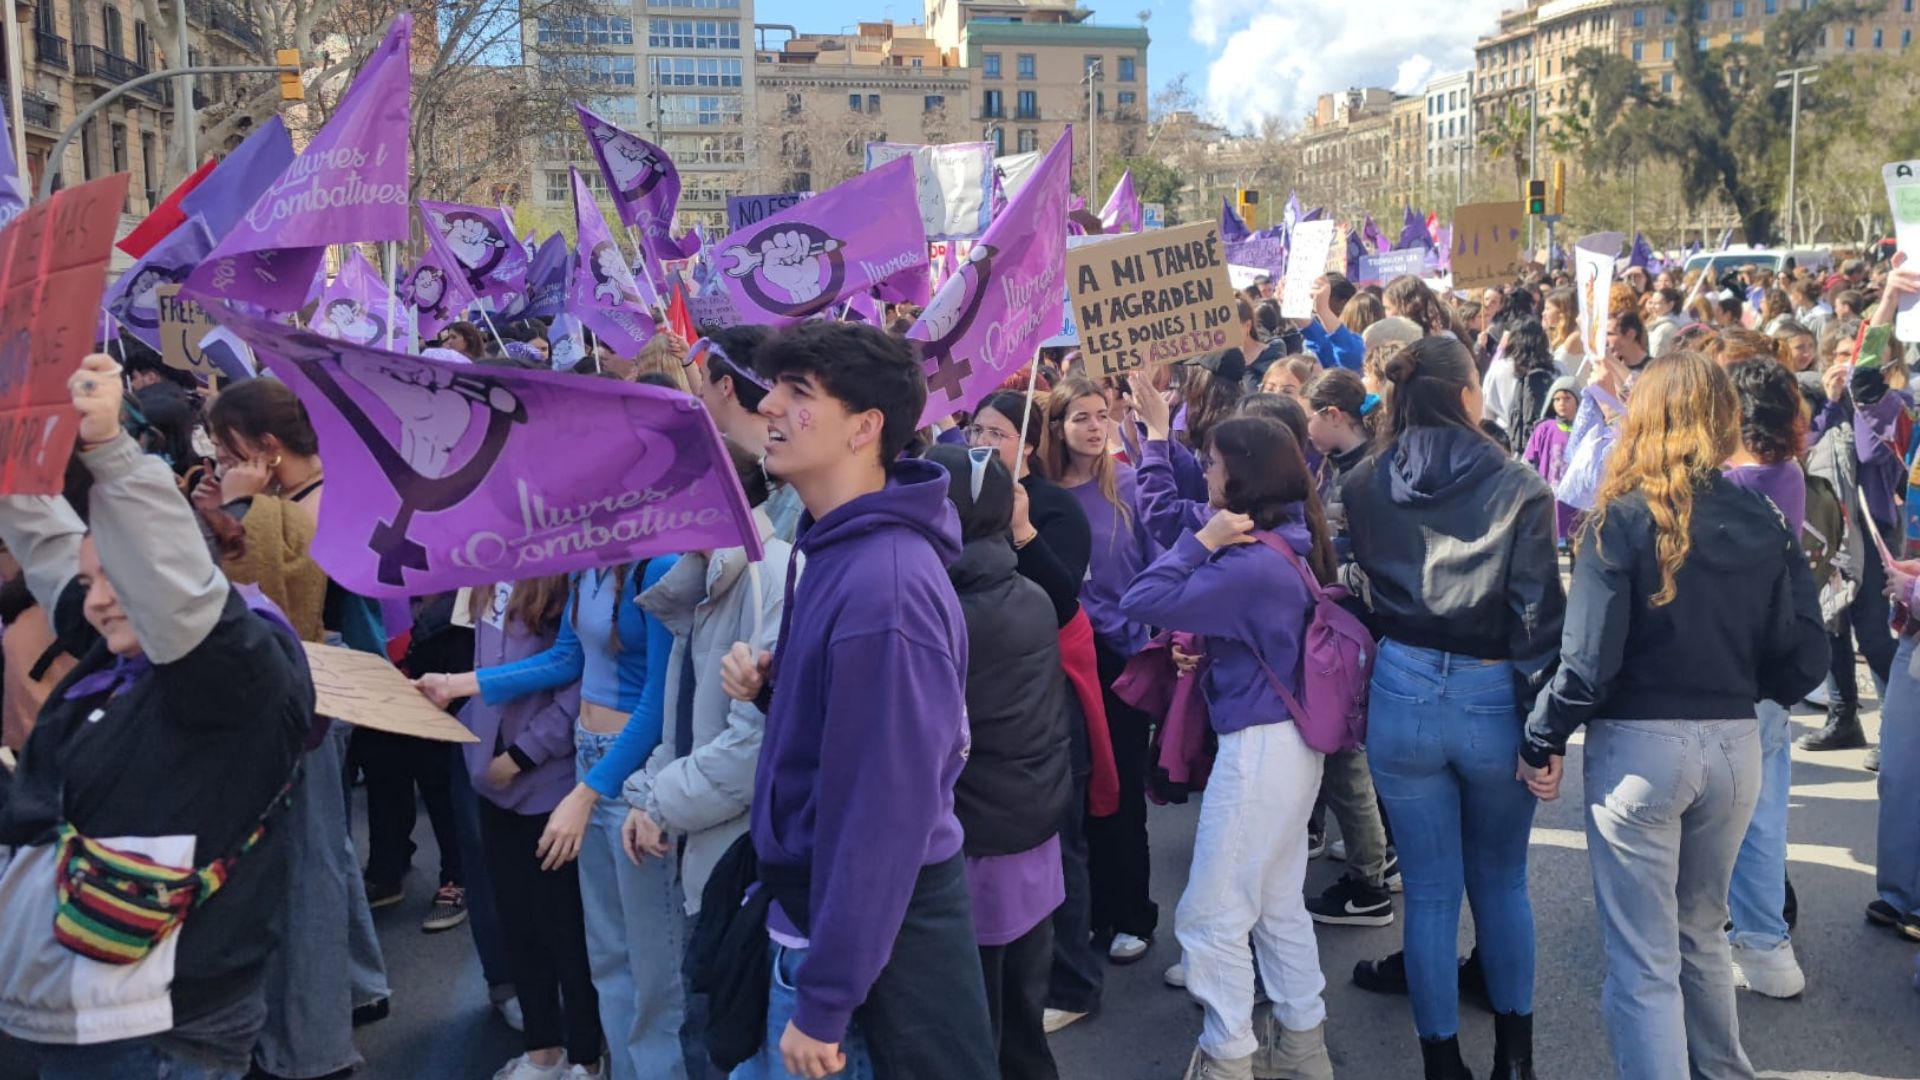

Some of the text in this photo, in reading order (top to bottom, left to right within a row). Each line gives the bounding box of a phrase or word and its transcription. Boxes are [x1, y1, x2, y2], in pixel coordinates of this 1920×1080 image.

[246, 170, 408, 232] Combatives
[738, 199, 763, 226] NO
[1079, 264, 1100, 294] A
[1111, 255, 1145, 287] MI
[1147, 229, 1220, 278] TAMBÉ
[1081, 278, 1214, 330] M'AGRADEN
[1087, 305, 1231, 355] LES DONES I NO
[1102, 329, 1227, 374] LES ASSETJO
